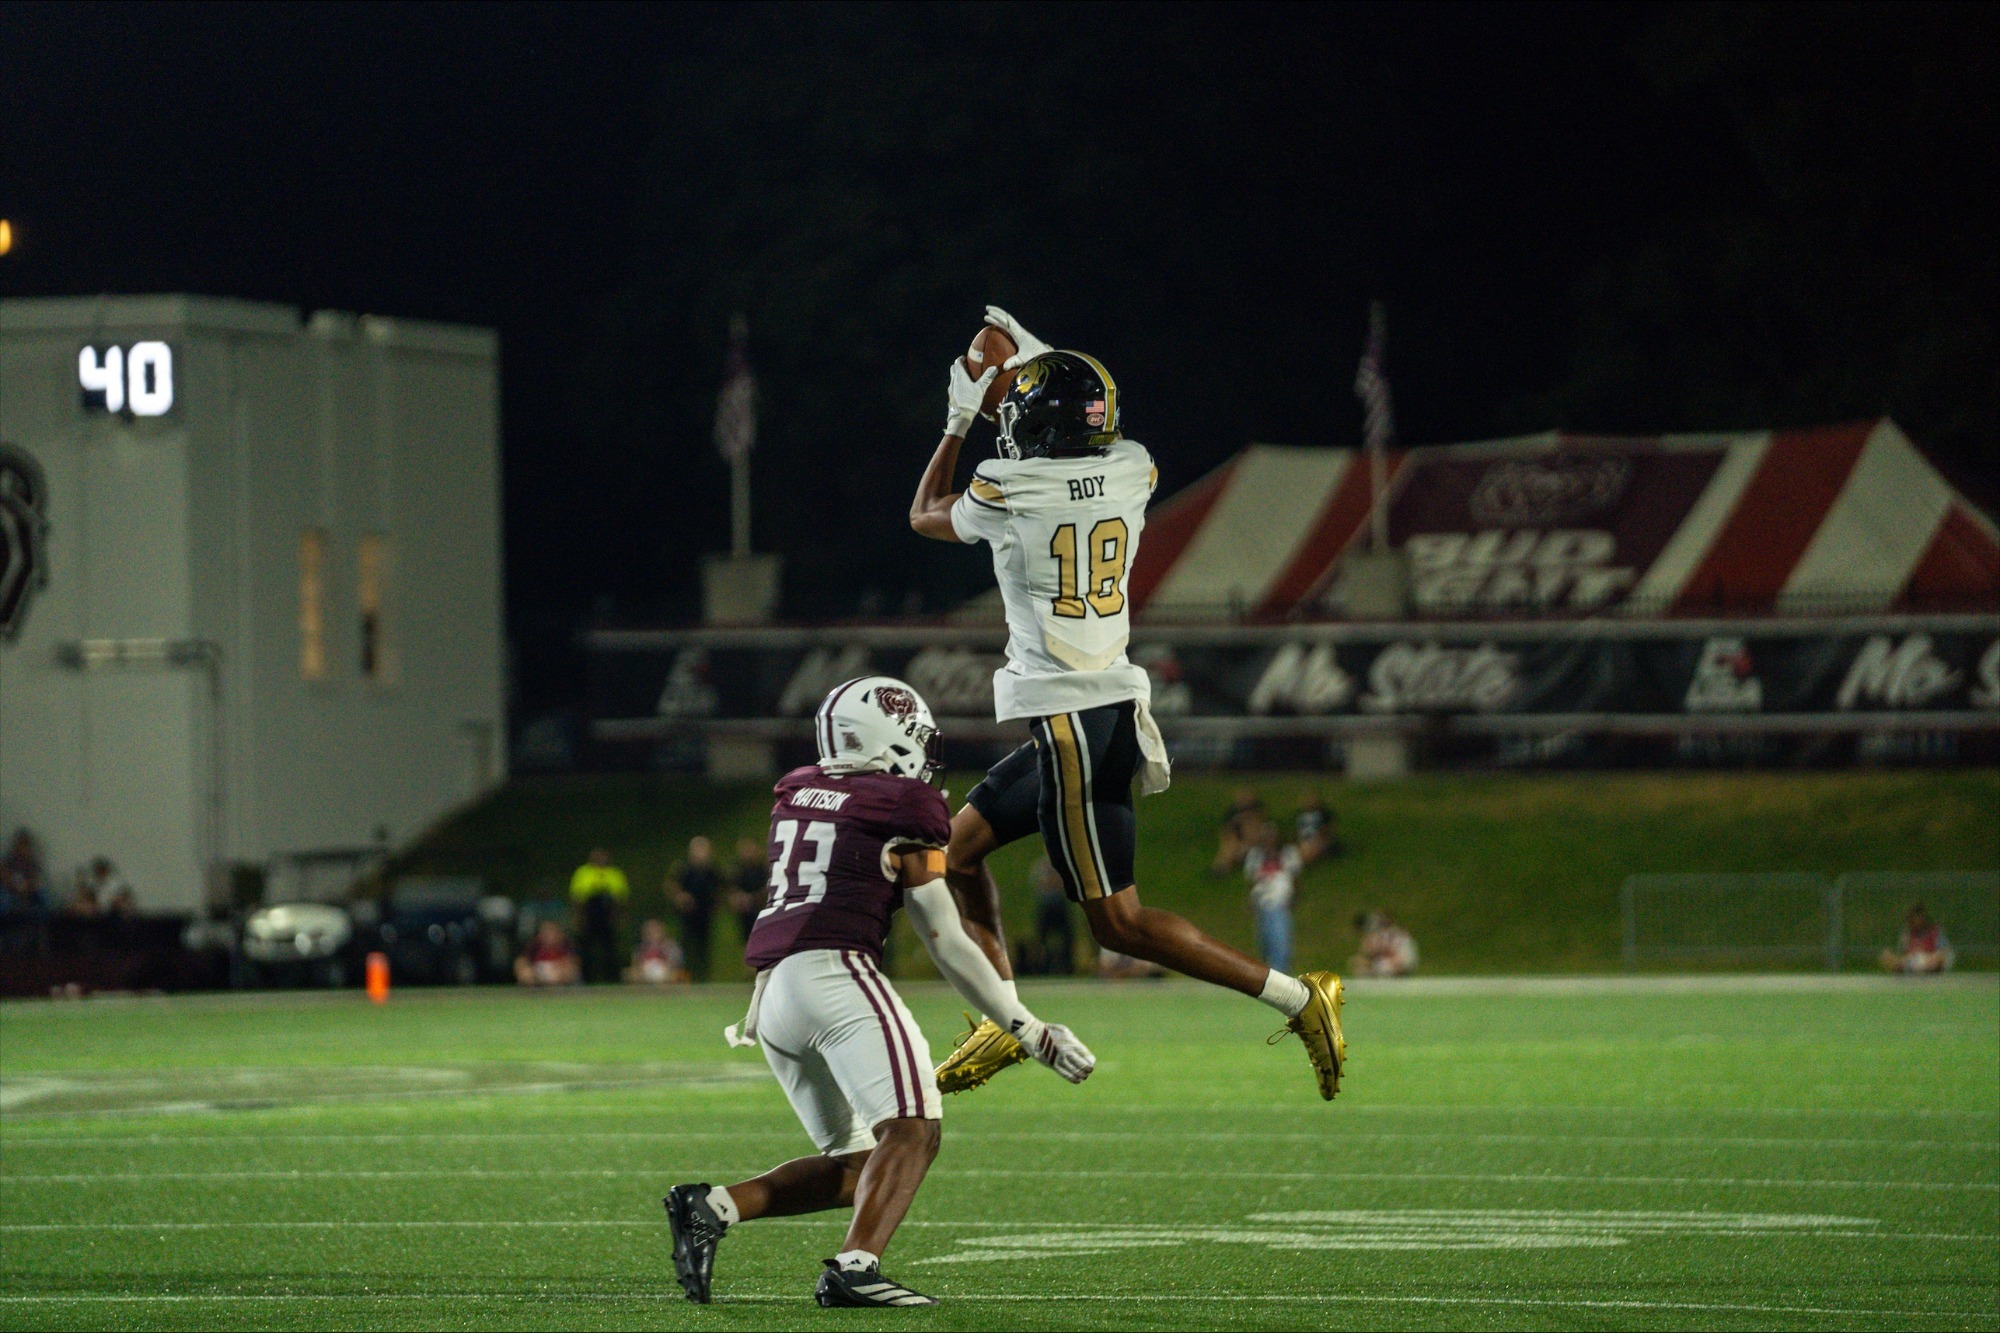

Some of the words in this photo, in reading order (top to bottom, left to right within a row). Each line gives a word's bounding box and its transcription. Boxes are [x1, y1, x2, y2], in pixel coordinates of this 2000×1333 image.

[79, 341, 173, 416] 40
[1067, 476, 1105, 500] ROY
[1050, 516, 1128, 619] 18
[791, 787, 851, 812] MATTISON
[757, 819, 836, 919] 33
